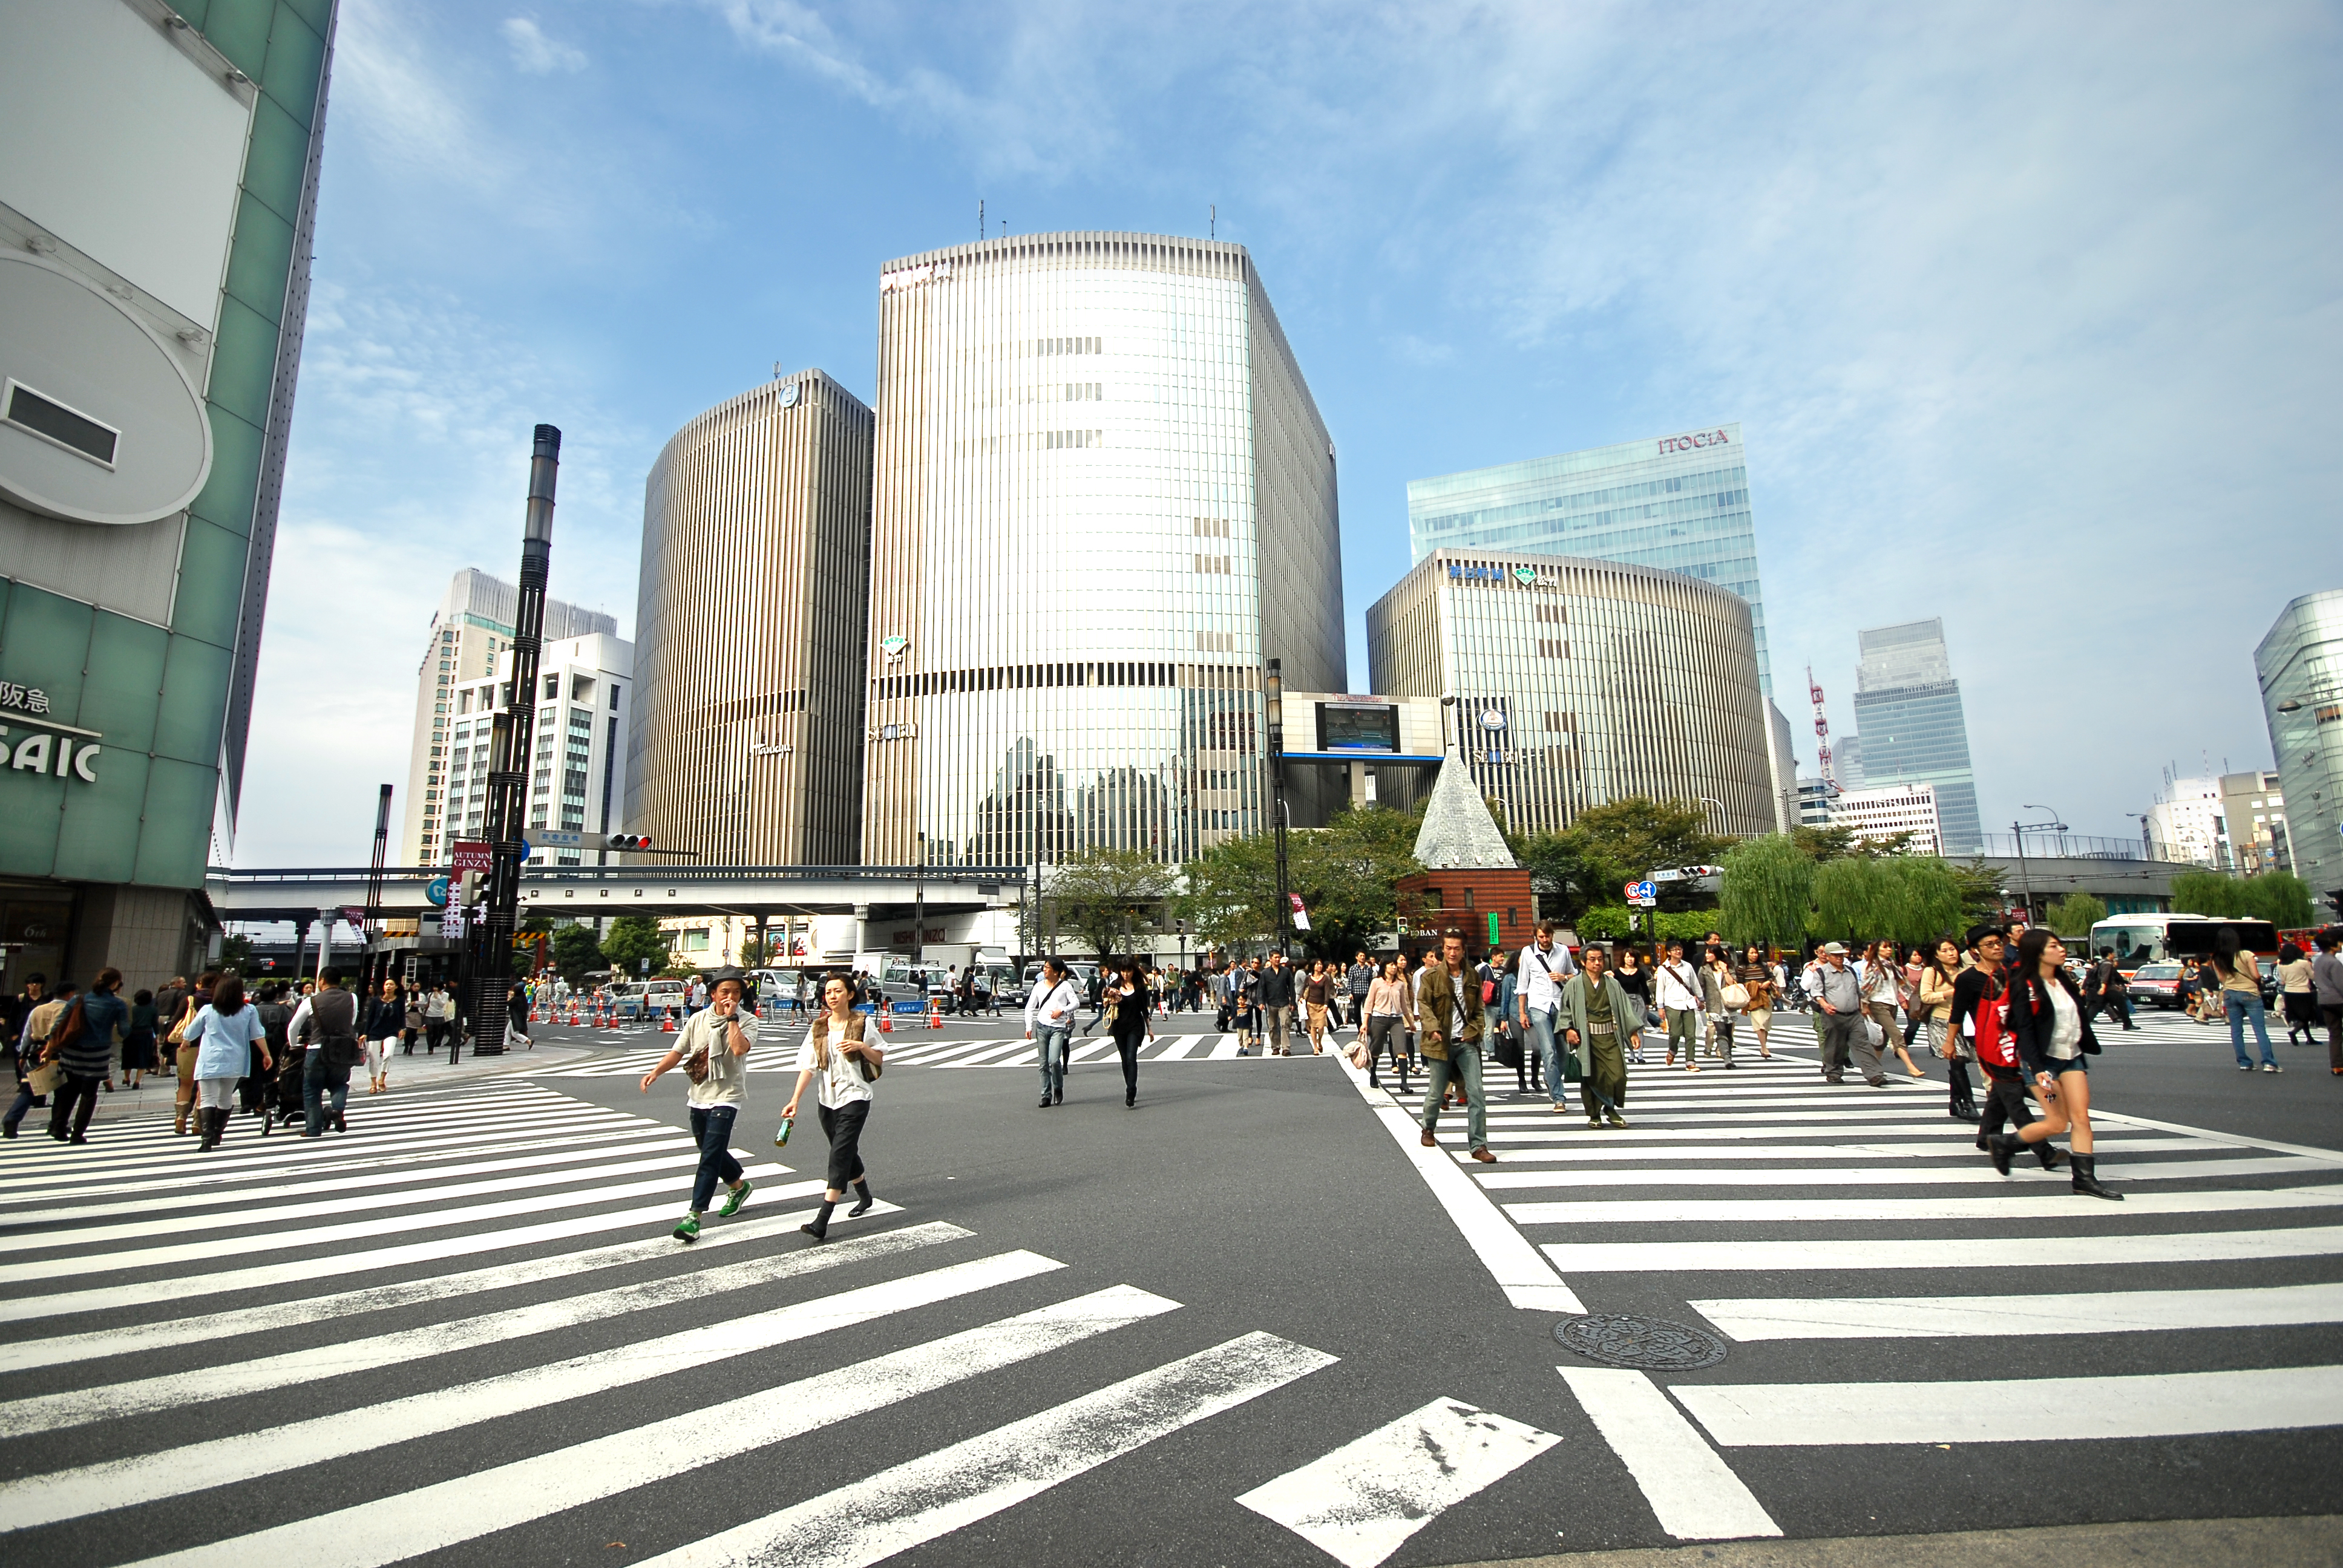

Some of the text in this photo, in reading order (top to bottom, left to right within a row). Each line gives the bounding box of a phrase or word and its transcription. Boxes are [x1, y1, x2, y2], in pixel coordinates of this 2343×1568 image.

[1449, 565, 1504, 581] 朝日新聞
[0, 681, 50, 713] 阪急
[753, 730, 792, 759] Hankyu
[1473, 750, 1518, 763] SEIBU
[454, 859, 488, 867] GINZA
[24, 924, 47, 938] 6th
